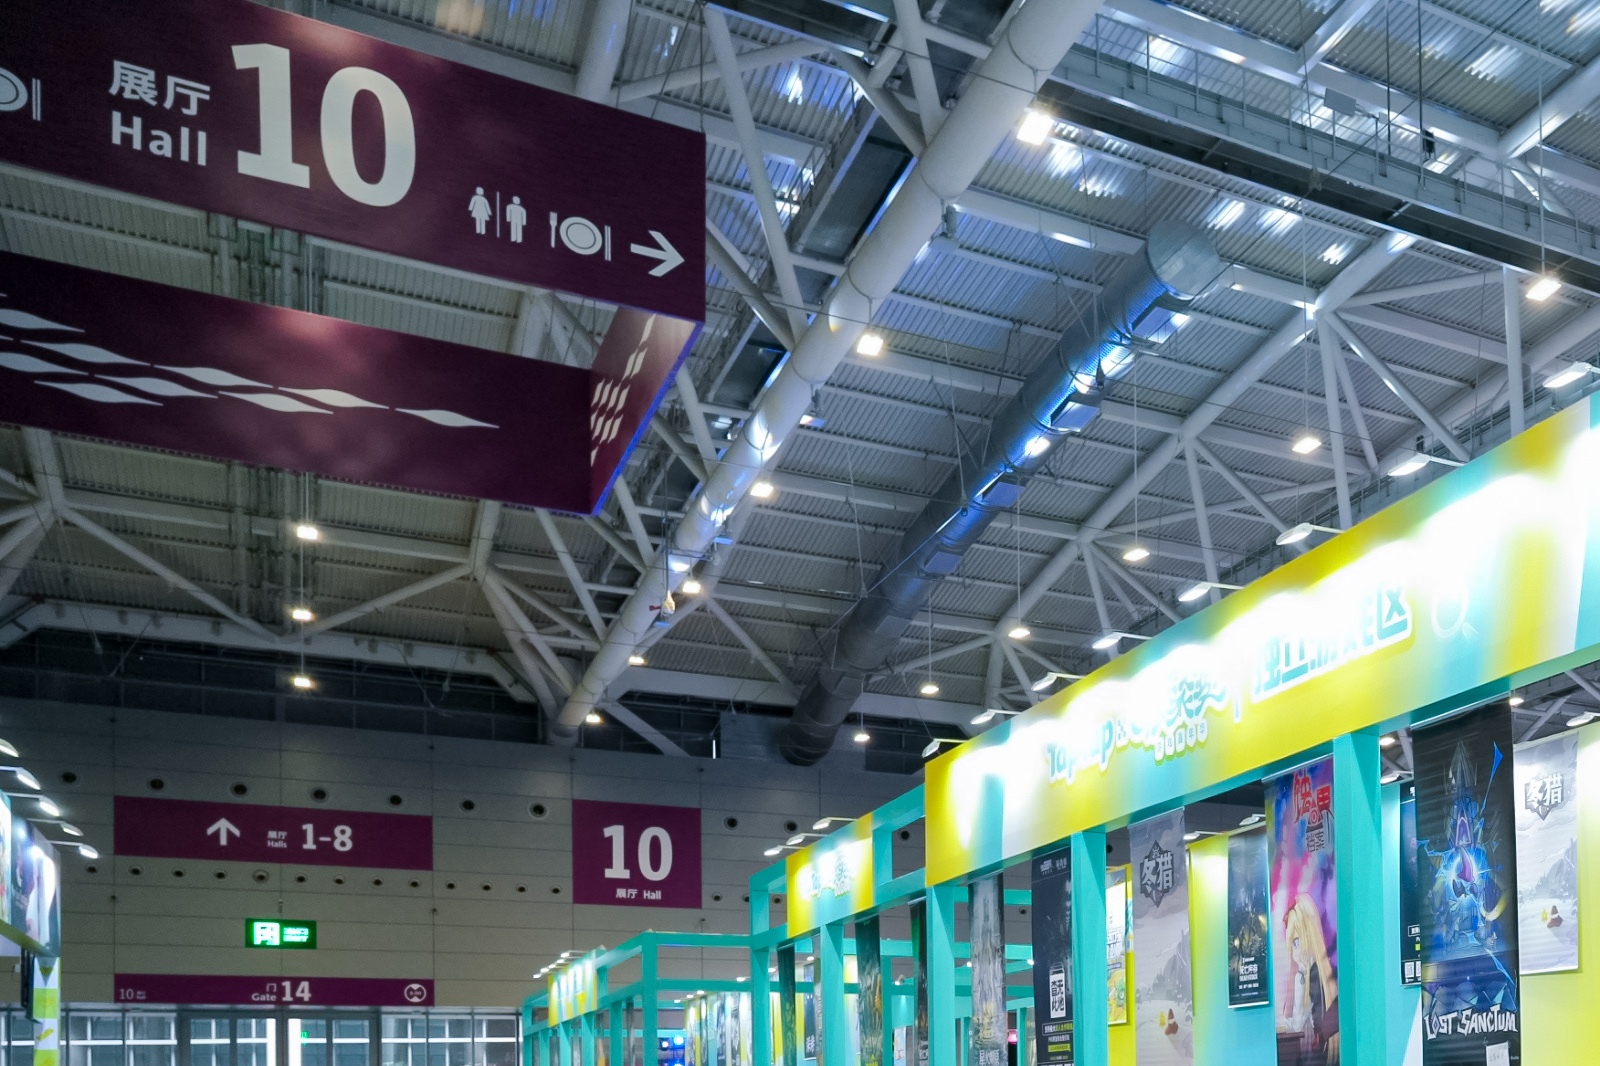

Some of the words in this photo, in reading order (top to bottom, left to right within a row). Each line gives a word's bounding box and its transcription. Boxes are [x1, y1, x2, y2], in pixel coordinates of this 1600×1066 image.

[109, 60, 211, 116] 展厅
[231, 43, 416, 207] 10
[111, 110, 207, 167] Hall
[267, 840, 287, 848] Halls
[302, 823, 353, 852] 1-8
[603, 825, 673, 881] 10
[1141, 852, 1173, 893] 冬猎
[615, 888, 638, 899] 展厅
[643, 890, 661, 900] Hall
[119, 988, 135, 1000] 10
[252, 992, 277, 1001] Gate
[266, 983, 277, 992] 门
[281, 980, 312, 1002] 14
[1423, 1011, 1456, 1040] LOST
[1457, 1004, 1518, 1036] SANCTUM
